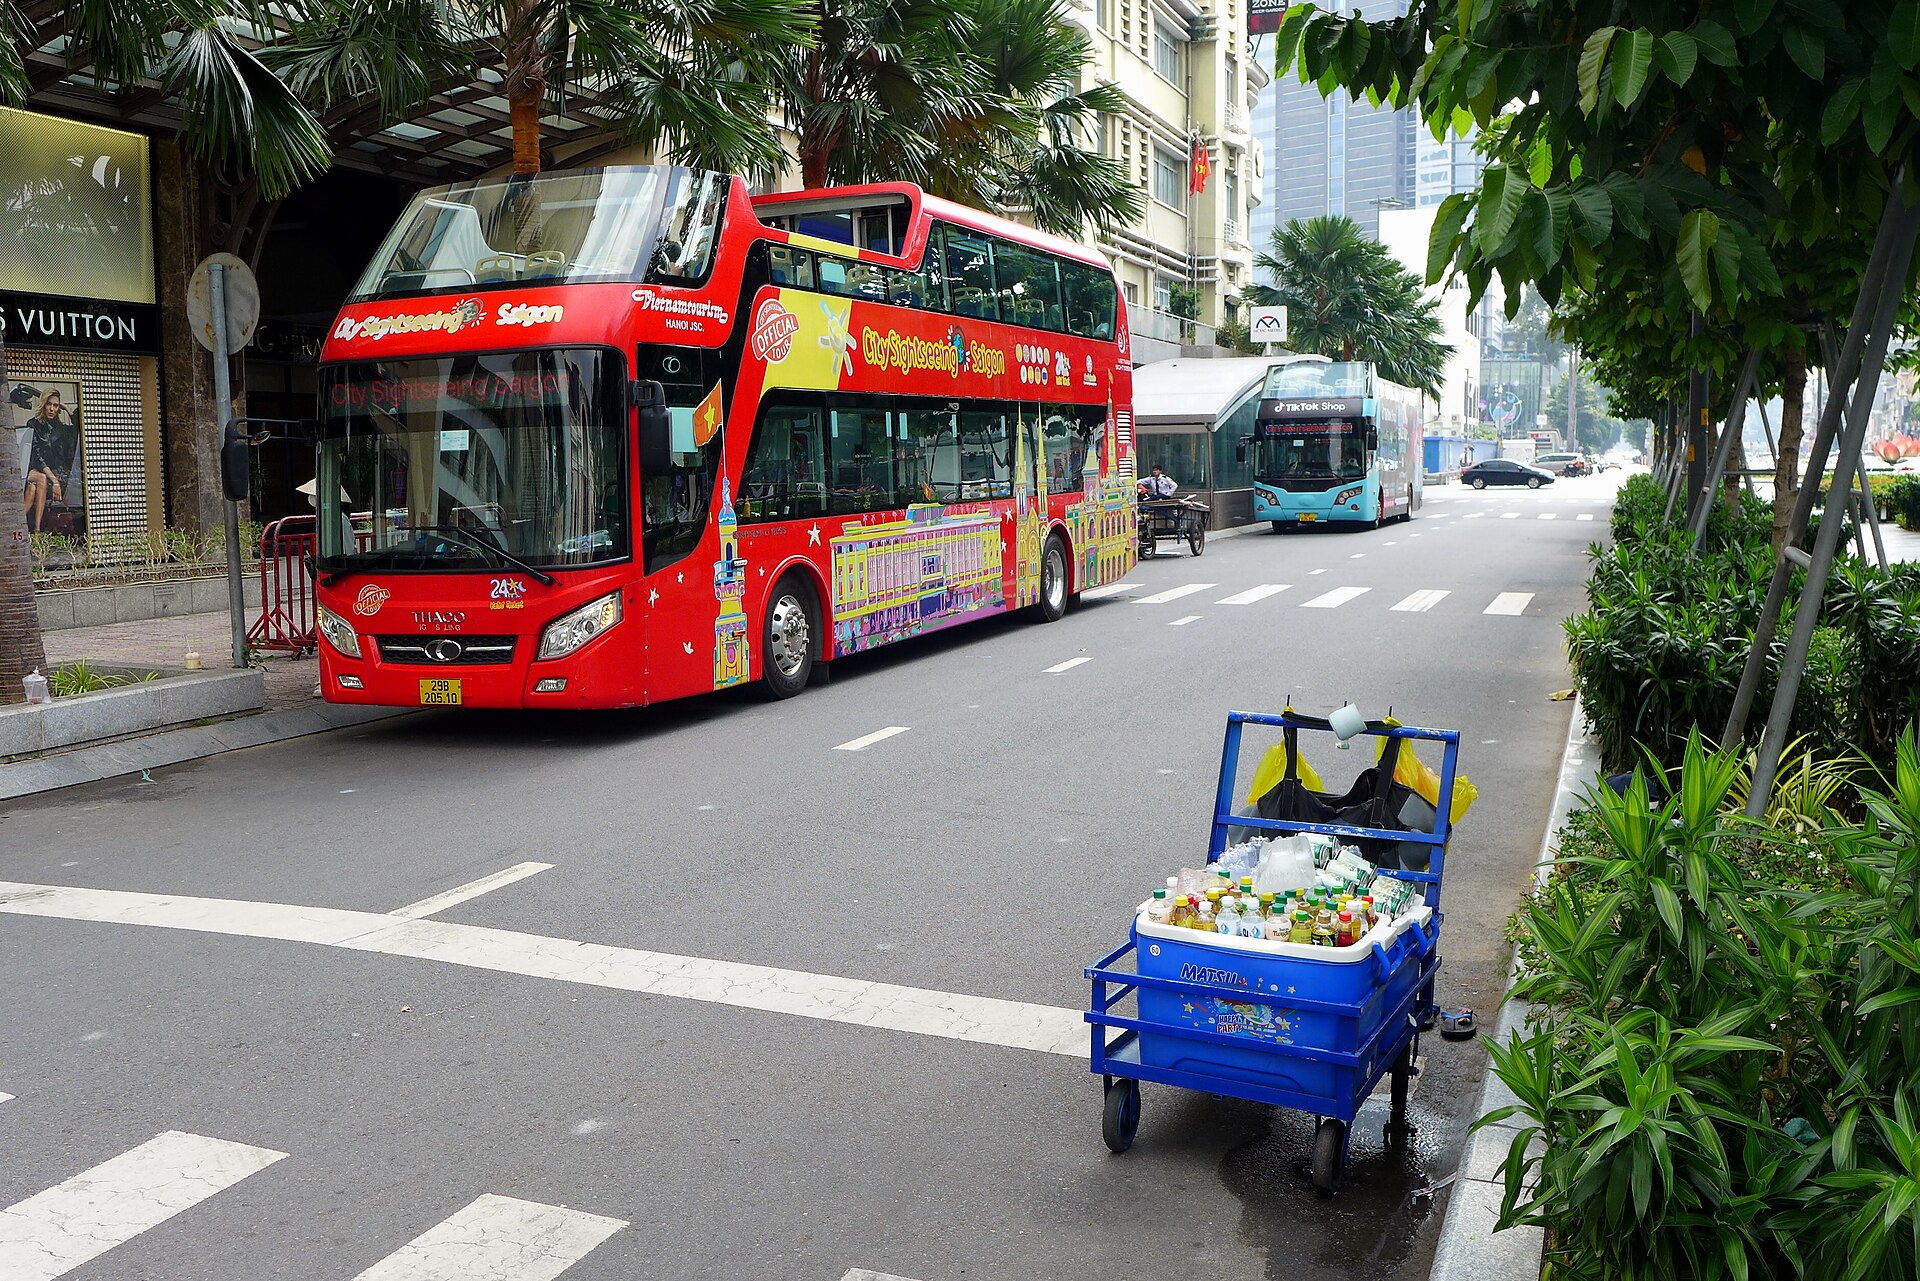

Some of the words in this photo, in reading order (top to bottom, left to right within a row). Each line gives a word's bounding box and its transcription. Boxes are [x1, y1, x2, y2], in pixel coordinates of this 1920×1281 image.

[496, 303, 564, 326] Saigon
[17, 308, 136, 342] VUITTON
[665, 318, 689, 331] HANOI
[689, 321, 705, 332] JSC.
[757, 315, 798, 353] OFFICIAL
[771, 339, 791, 359] TOUR
[970, 339, 1006, 379] Saigon
[1285, 402, 1319, 412] TikTok
[1321, 402, 1346, 412] Shop
[12, 531, 23, 541] 15
[490, 579, 509, 599] 24
[356, 590, 387, 611] OFFICIAL
[411, 611, 466, 623] THACO
[431, 680, 450, 692] 29B
[424, 692, 458, 704] 205.10
[1216, 1023, 1243, 1033] PARTY
